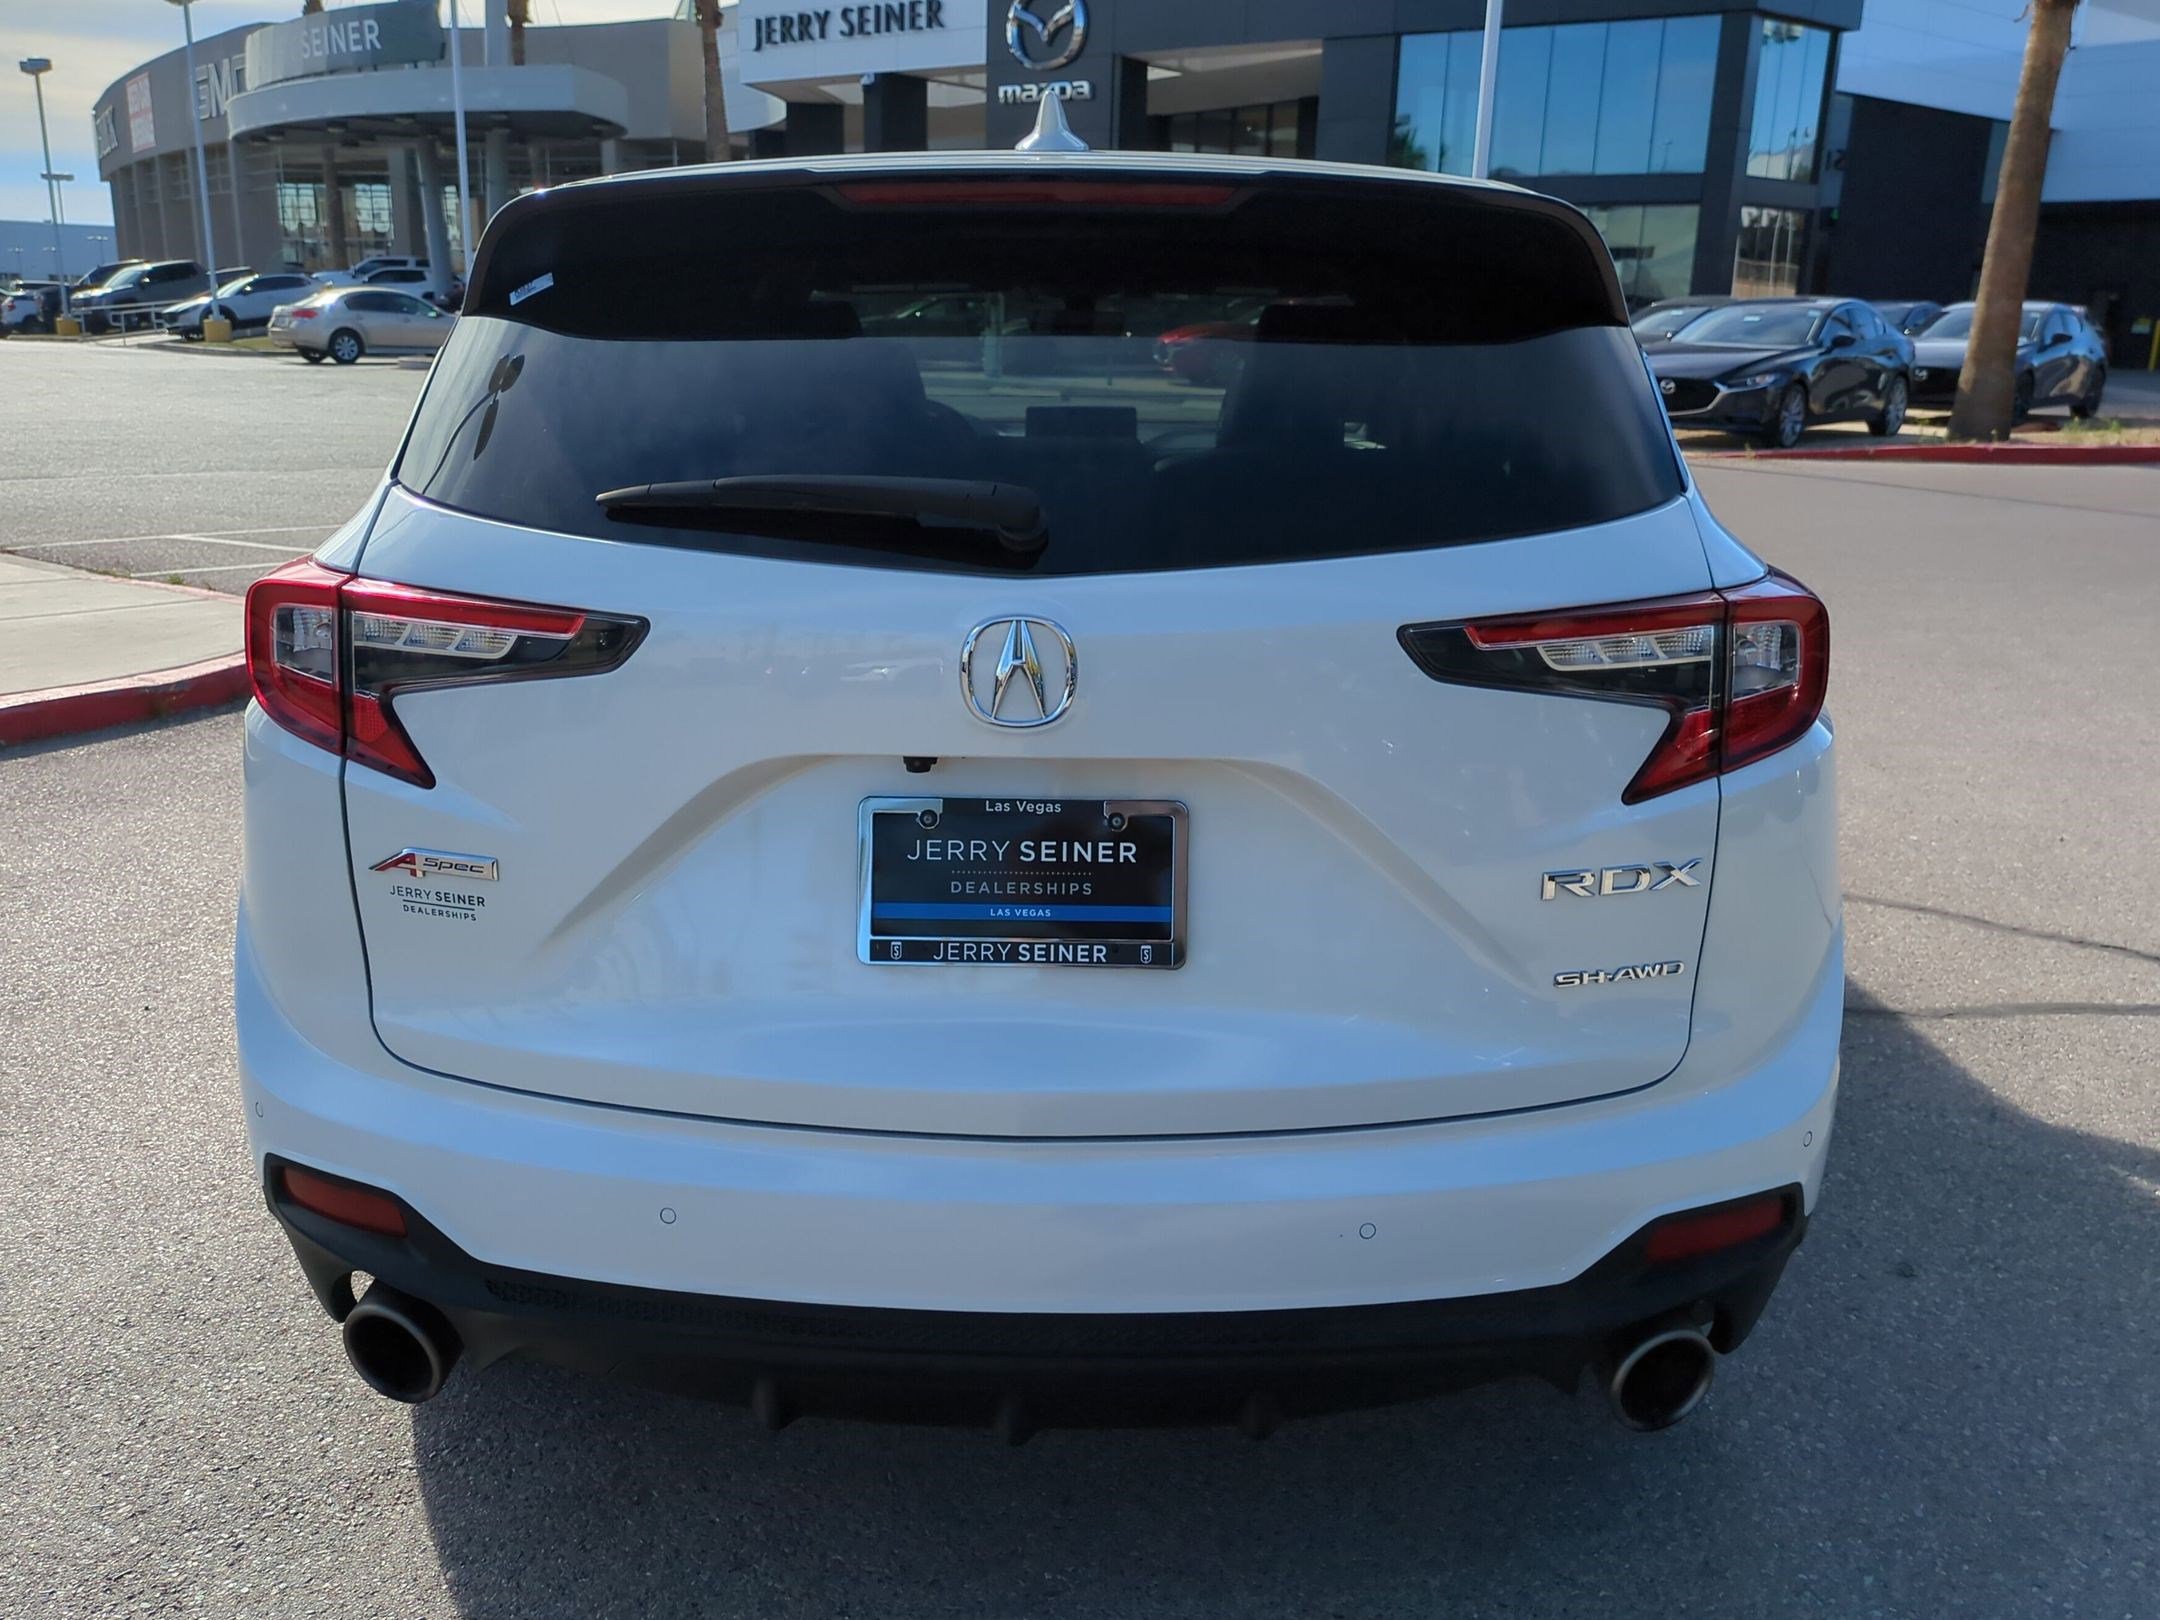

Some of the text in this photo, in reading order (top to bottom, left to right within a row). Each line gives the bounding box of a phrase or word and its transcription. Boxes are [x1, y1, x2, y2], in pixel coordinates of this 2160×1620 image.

[753, 0, 945, 52] JERRY SEINER
[302, 19, 382, 59] SEINER
[985, 800, 1062, 814] Las Vegas
[907, 840, 1137, 863] JERRY SEINER
[951, 881, 1092, 896] DEALERSHIPS
[1541, 857, 1702, 900] RDX
[390, 885, 486, 907] JERRY SEINER
[402, 904, 477, 921] DEALERSHIPS
[990, 908, 1051, 917] LAS VEGAS
[933, 943, 1106, 963] JERRY SEINER
[1553, 960, 1685, 988] SH-AWD
